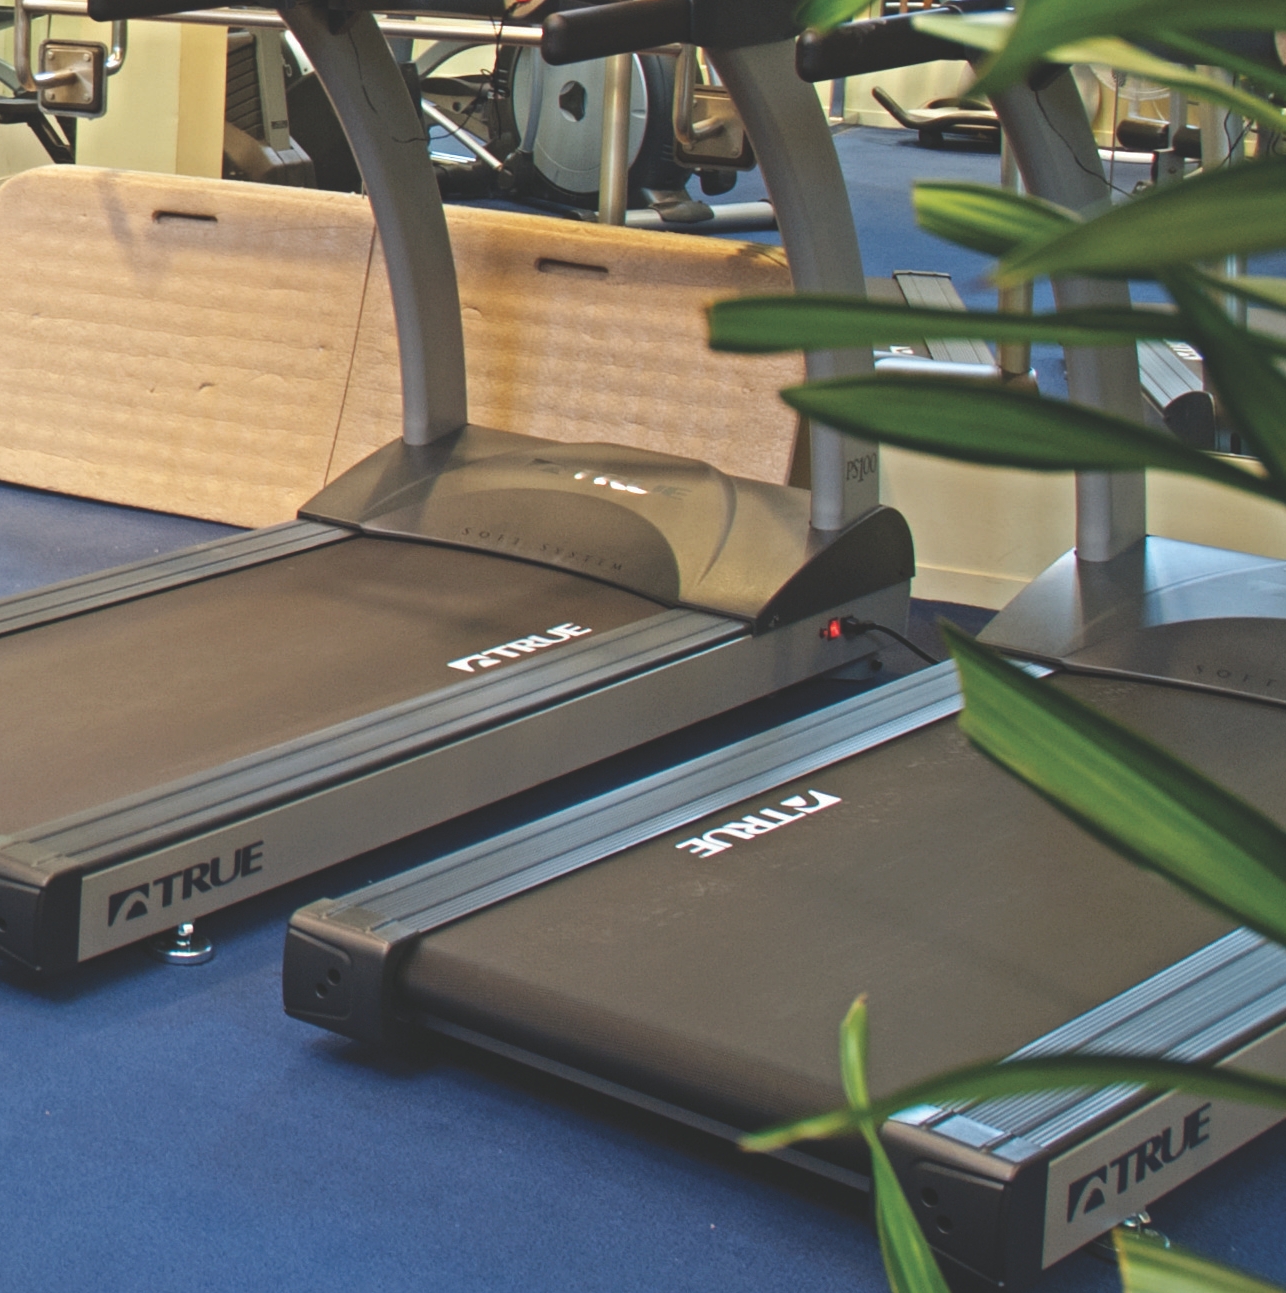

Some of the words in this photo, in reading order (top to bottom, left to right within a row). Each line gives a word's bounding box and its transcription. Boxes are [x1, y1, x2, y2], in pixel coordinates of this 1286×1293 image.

[481, 621, 593, 659] TRUE
[675, 807, 807, 858] TRUE
[152, 840, 264, 908] TRUE
[1108, 1102, 1212, 1195] TRUE
